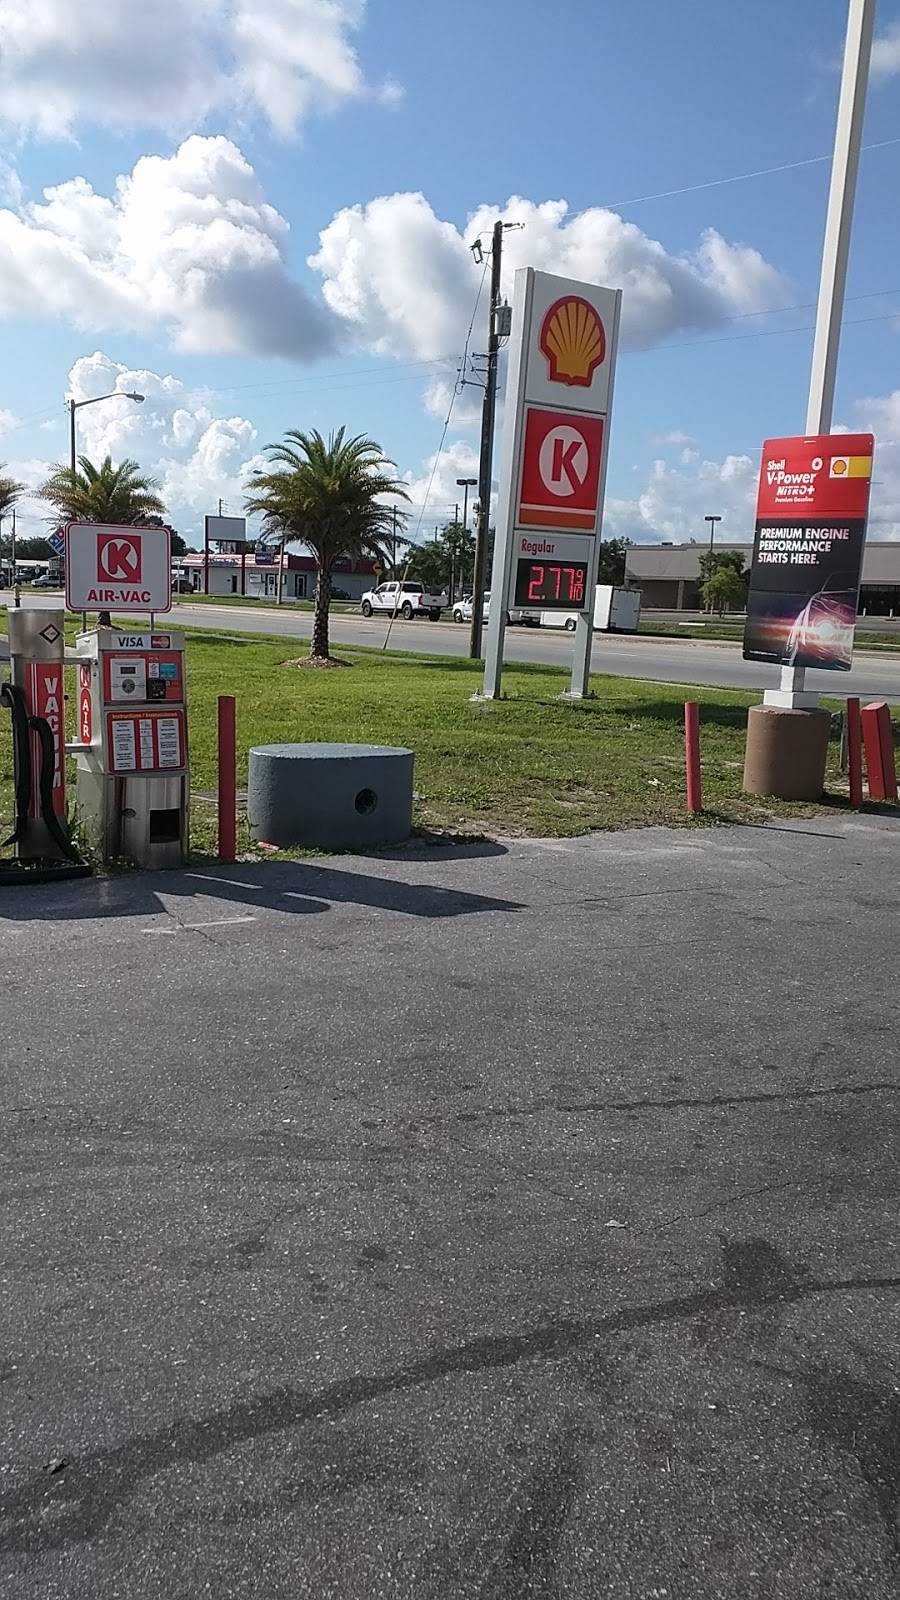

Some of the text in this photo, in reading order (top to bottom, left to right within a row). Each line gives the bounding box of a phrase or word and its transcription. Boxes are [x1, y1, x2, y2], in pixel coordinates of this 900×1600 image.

[551, 438, 584, 492] K
[767, 459, 786, 470] Shell
[767, 471, 817, 485] V-Power
[760, 528, 850, 540] PREMIUM ENGINE
[521, 538, 555, 555] Regular
[758, 540, 832, 552] PERFORMANCE
[107, 541, 138, 579] K
[757, 552, 820, 565] STARTS HERE.
[87, 589, 152, 603] AIR-VAC
[117, 636, 144, 648] VISA
[82, 698, 90, 738] AIR
